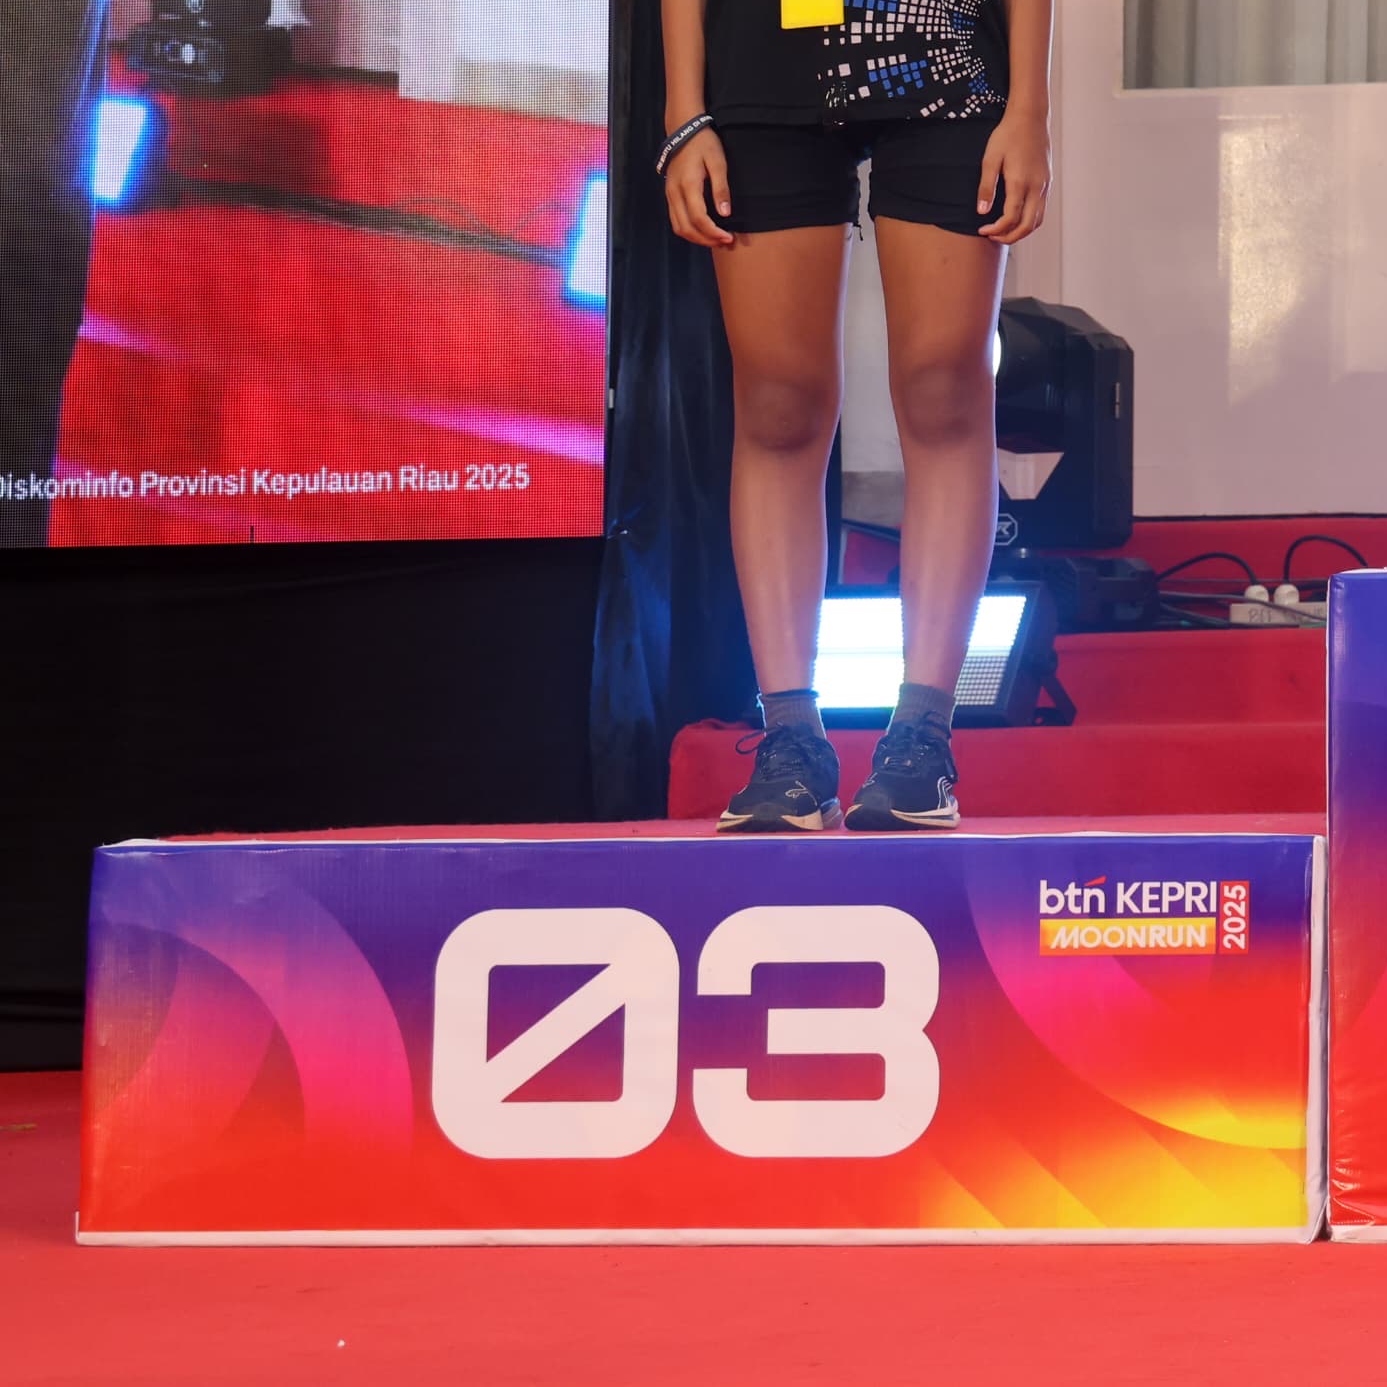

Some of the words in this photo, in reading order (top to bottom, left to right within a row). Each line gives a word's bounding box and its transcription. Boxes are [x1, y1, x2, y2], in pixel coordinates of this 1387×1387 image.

[140, 467, 247, 497] Provinsi
[253, 465, 393, 500] Kepulauan
[399, 463, 458, 492] Riau
[464, 463, 530, 491] 2025
[1040, 876, 1107, 913] btn
[1116, 881, 1217, 913] KEPRI
[1223, 885, 1247, 950] 2025
[1051, 925, 1207, 949] MOONRUN
[432, 906, 940, 1159] 03
